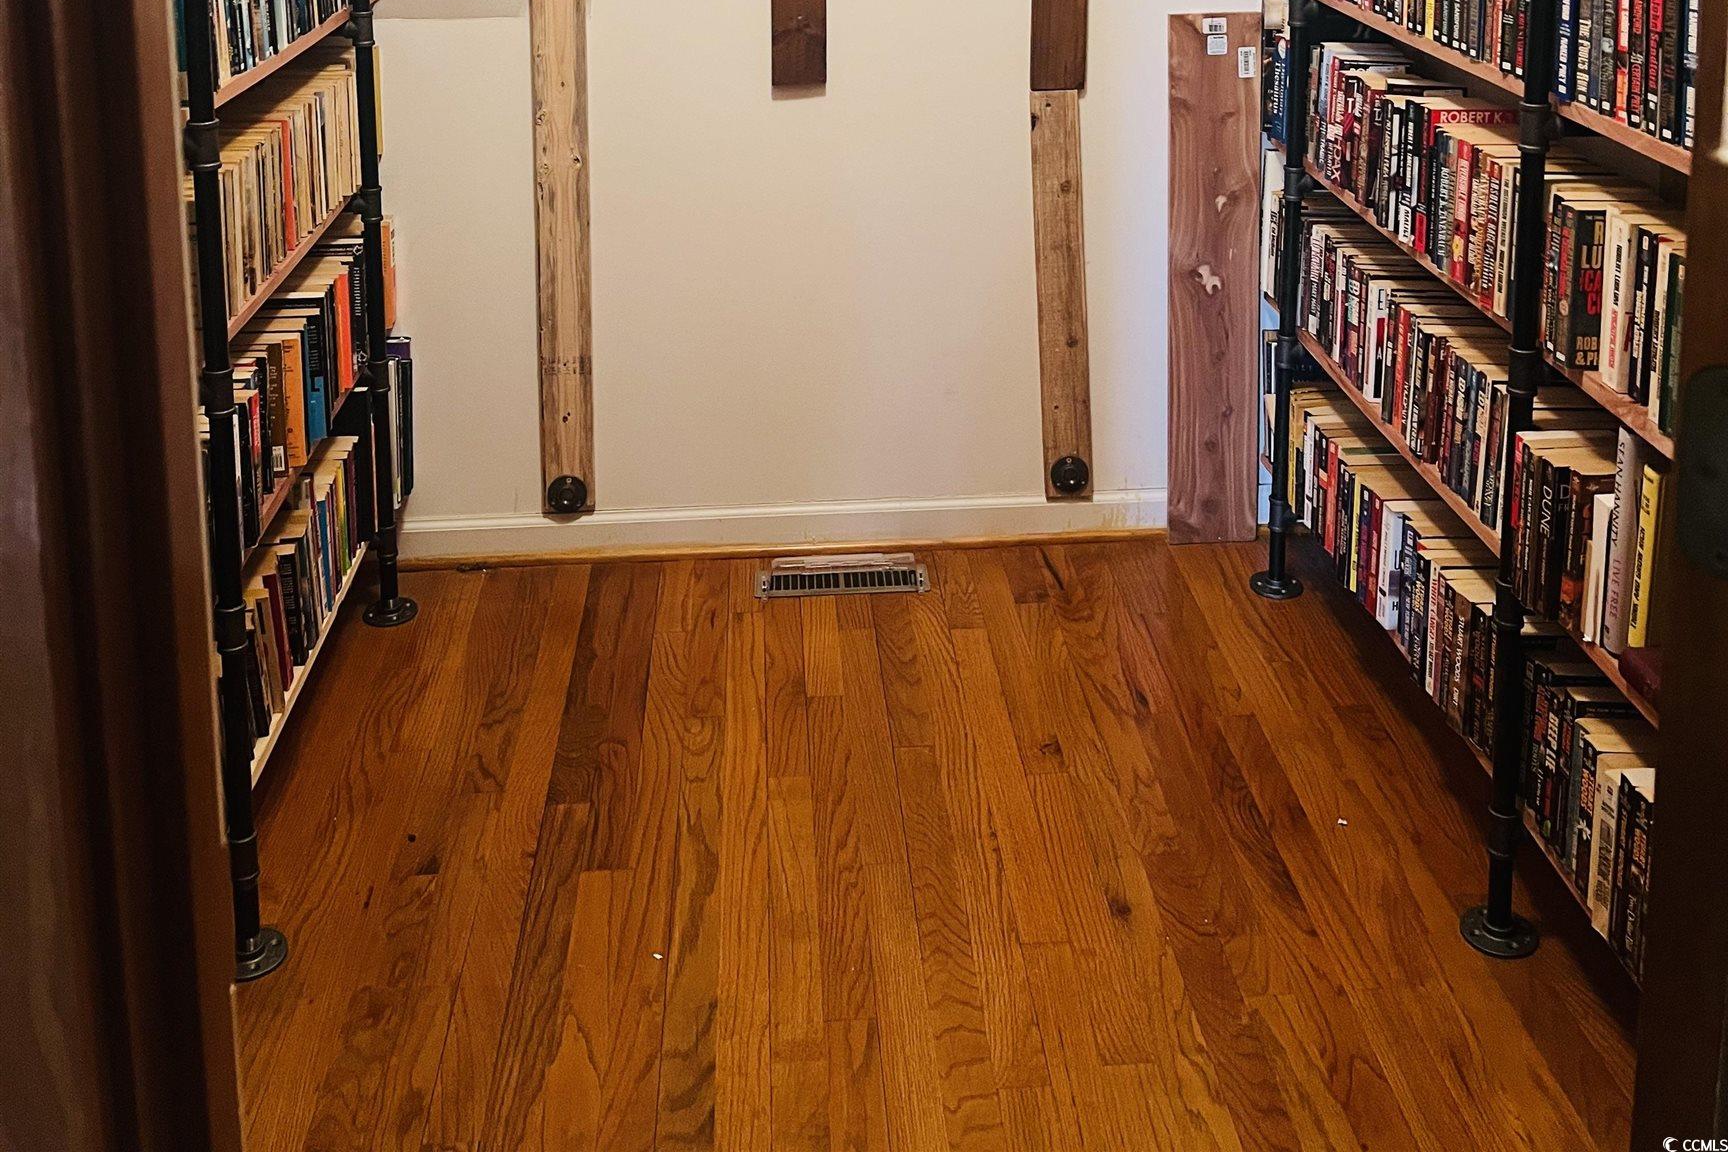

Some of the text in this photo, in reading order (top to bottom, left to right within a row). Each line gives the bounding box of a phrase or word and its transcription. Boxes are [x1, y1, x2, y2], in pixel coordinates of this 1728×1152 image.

[1453, 2, 1461, 39] SANDFORD
[1688, 12, 1698, 54] SANDFORD
[1560, 37, 1568, 62] NAKED
[1577, 19, 1591, 91] THE FOOL'S RUN
[1649, 33, 1659, 89] Sandford
[1666, 29, 1677, 60] PREY
[1558, 63, 1567, 84] PREY
[1632, 63, 1641, 93] CERTAIN
[1440, 111, 1490, 123] ROBERT
[1631, 94, 1641, 114] PREY
[1386, 120, 1392, 130] NO
[1685, 117, 1694, 136] PREY
[1331, 137, 1343, 182] HOAX
[1459, 160, 1469, 197] REVERSIBLE
[1437, 167, 1449, 256] ROBERT TANENBAUM
[1479, 173, 1489, 224] TANENBAUM
[1486, 177, 1500, 244] ABSOLUTE RAGE
[1270, 211, 1278, 226] ICE
[1612, 274, 1621, 307] LUDLUM
[1652, 310, 1660, 339] ROBERT
[1458, 377, 1465, 391] ED
[1539, 486, 1553, 538] DUNE
[1612, 441, 1625, 547] SEAN HANNITY
[1608, 558, 1622, 619] LIVE FREE
[1428, 578, 1438, 640] WHITE CARGO
[1452, 615, 1465, 707] STUART WOODS DIRT
[1545, 712, 1559, 774] DEEP LIE
[1580, 768, 1589, 811] WOODS
[1587, 775, 1595, 817] STUART
[1620, 808, 1628, 846] STUART
[1633, 828, 1641, 862] WOODS
